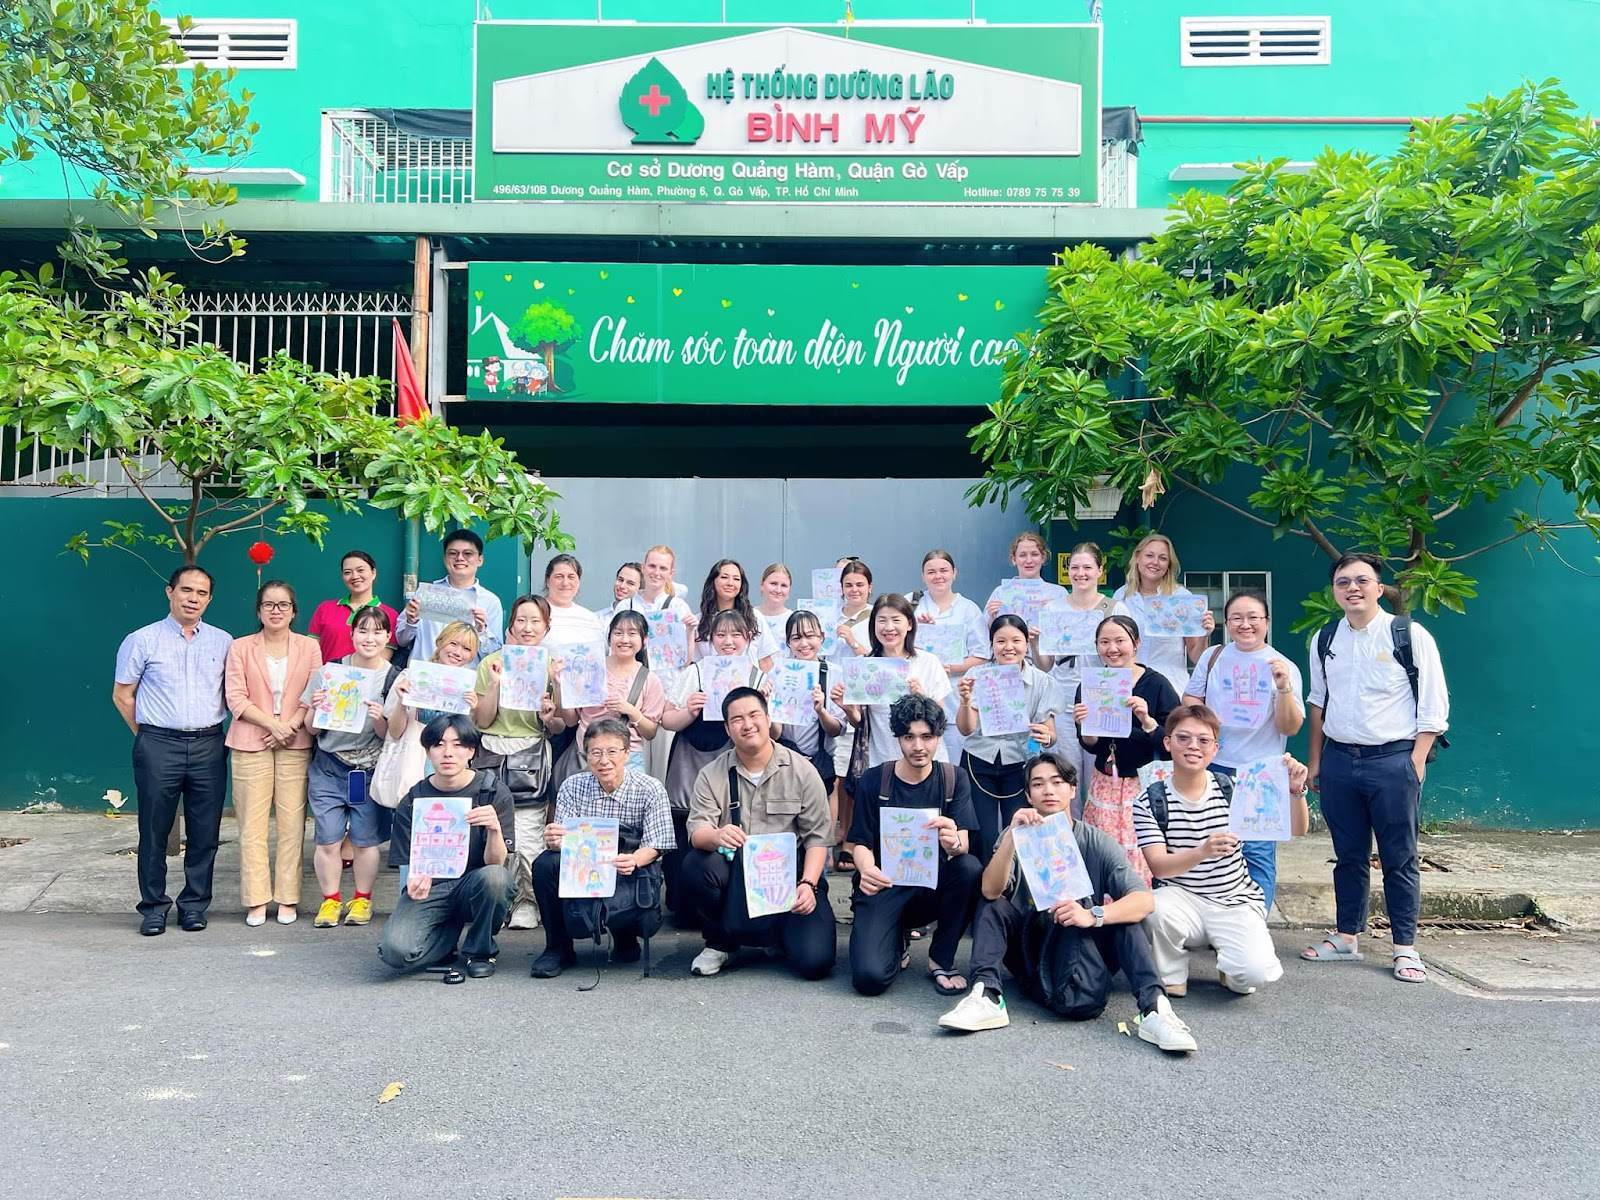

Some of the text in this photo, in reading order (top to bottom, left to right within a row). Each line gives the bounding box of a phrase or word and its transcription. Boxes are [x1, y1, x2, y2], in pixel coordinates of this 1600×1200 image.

[707, 64, 955, 104] HỆ THỐNG DƯỠNG LÃO
[747, 103, 925, 143] BÌNH MỸ
[607, 158, 969, 182] Cơ sở Dương Quảng Hàm, Quận Gò Vấp
[493, 185, 547, 195] 496/63/10B
[551, 185, 584, 197] Dương
[589, 184, 622, 197] Quảng
[657, 185, 696, 198] Phường
[714, 186, 724, 197] Q.
[729, 186, 743, 197] Gò
[749, 185, 770, 198] Vấp,
[776, 187, 791, 197] TP.
[795, 185, 809, 197] Hồ
[814, 186, 831, 197] Chí
[835, 187, 859, 197] Minh
[964, 187, 1080, 197] Hotline: 0789 75 75 39
[588, 315, 675, 364] Chăm
[680, 330, 726, 365] sóc
[732, 328, 798, 369] toàn
[804, 318, 867, 375] diện
[873, 317, 966, 387] Người
